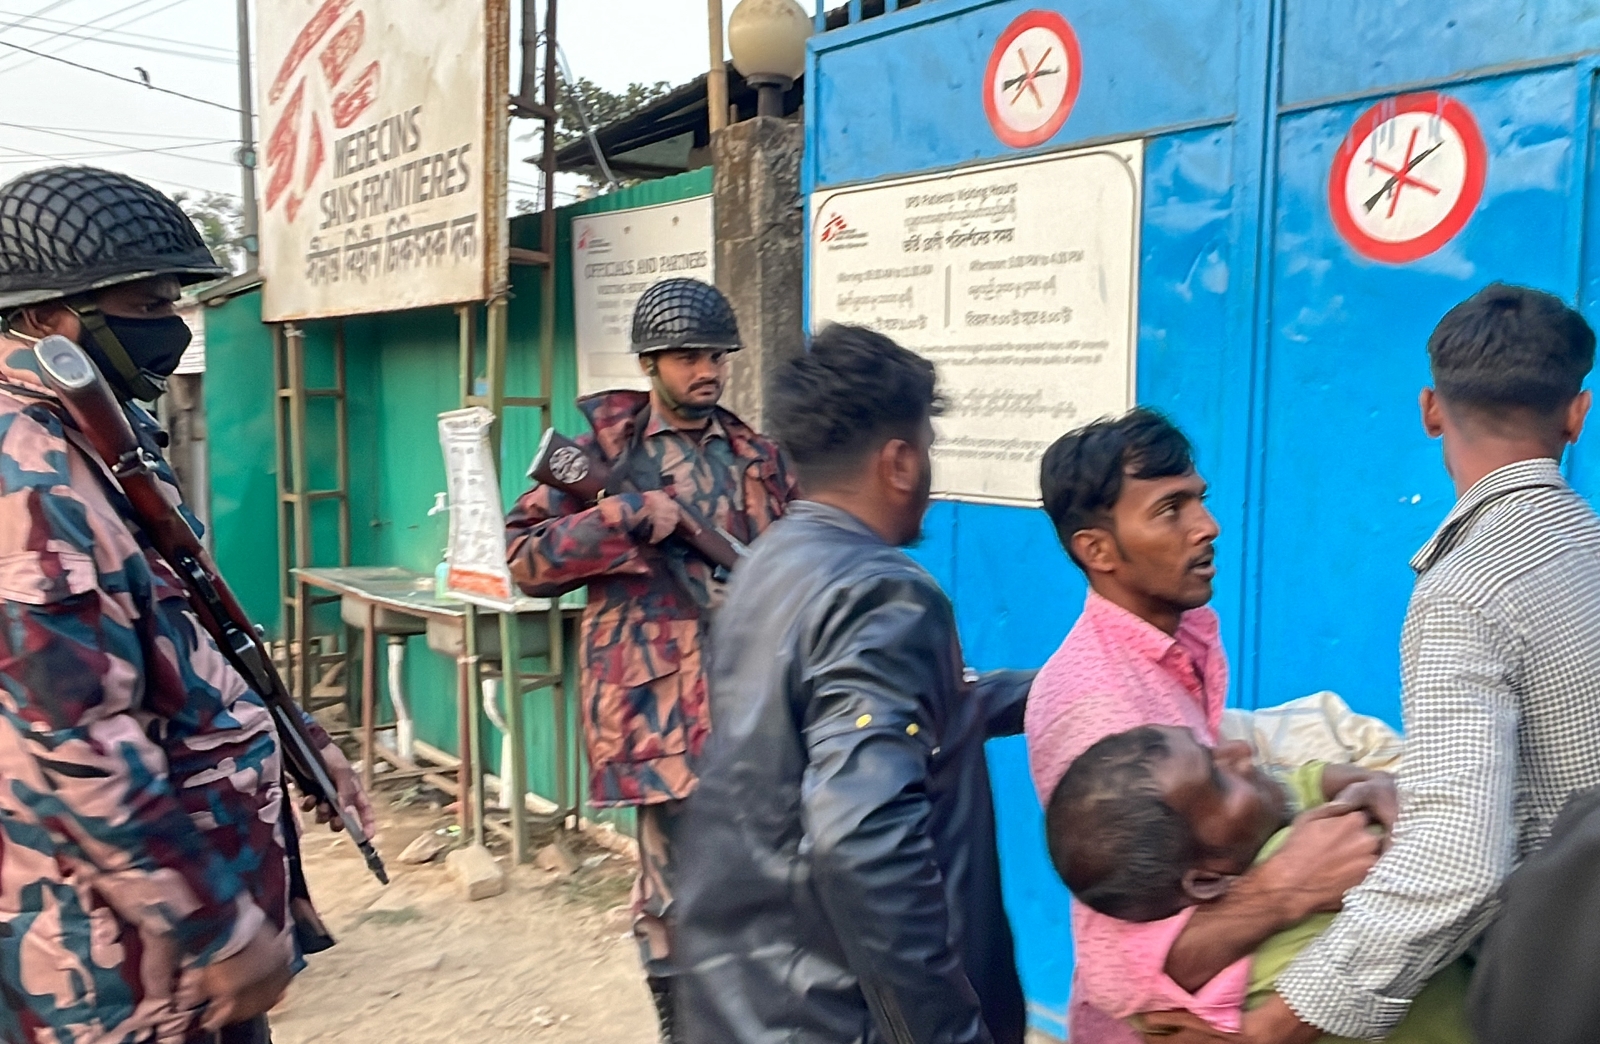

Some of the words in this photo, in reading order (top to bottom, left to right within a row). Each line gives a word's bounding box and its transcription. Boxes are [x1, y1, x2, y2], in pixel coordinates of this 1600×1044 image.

[333, 105, 422, 178] MEDECINS
[319, 180, 360, 230] SANS
[360, 143, 472, 220] FRONTIERES
